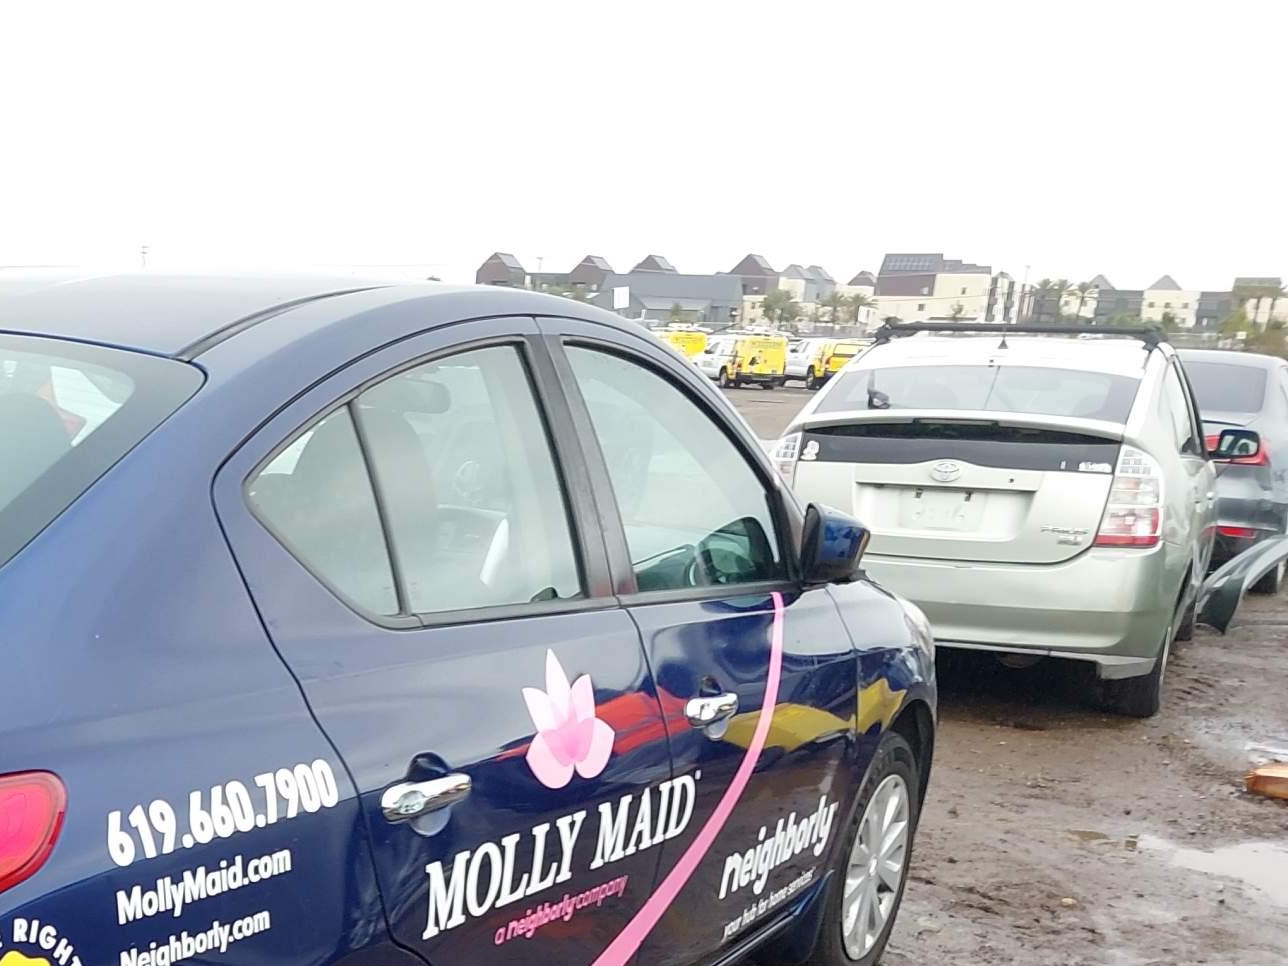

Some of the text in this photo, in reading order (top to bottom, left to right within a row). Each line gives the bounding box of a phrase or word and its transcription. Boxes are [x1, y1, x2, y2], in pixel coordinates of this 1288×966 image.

[107, 758, 339, 867] 619.660.7900
[718, 795, 839, 900] neighborly
[116, 849, 292, 925] MollyMaid.com
[421, 809, 588, 942] MOLLY
[495, 875, 628, 945] a neighborly company
